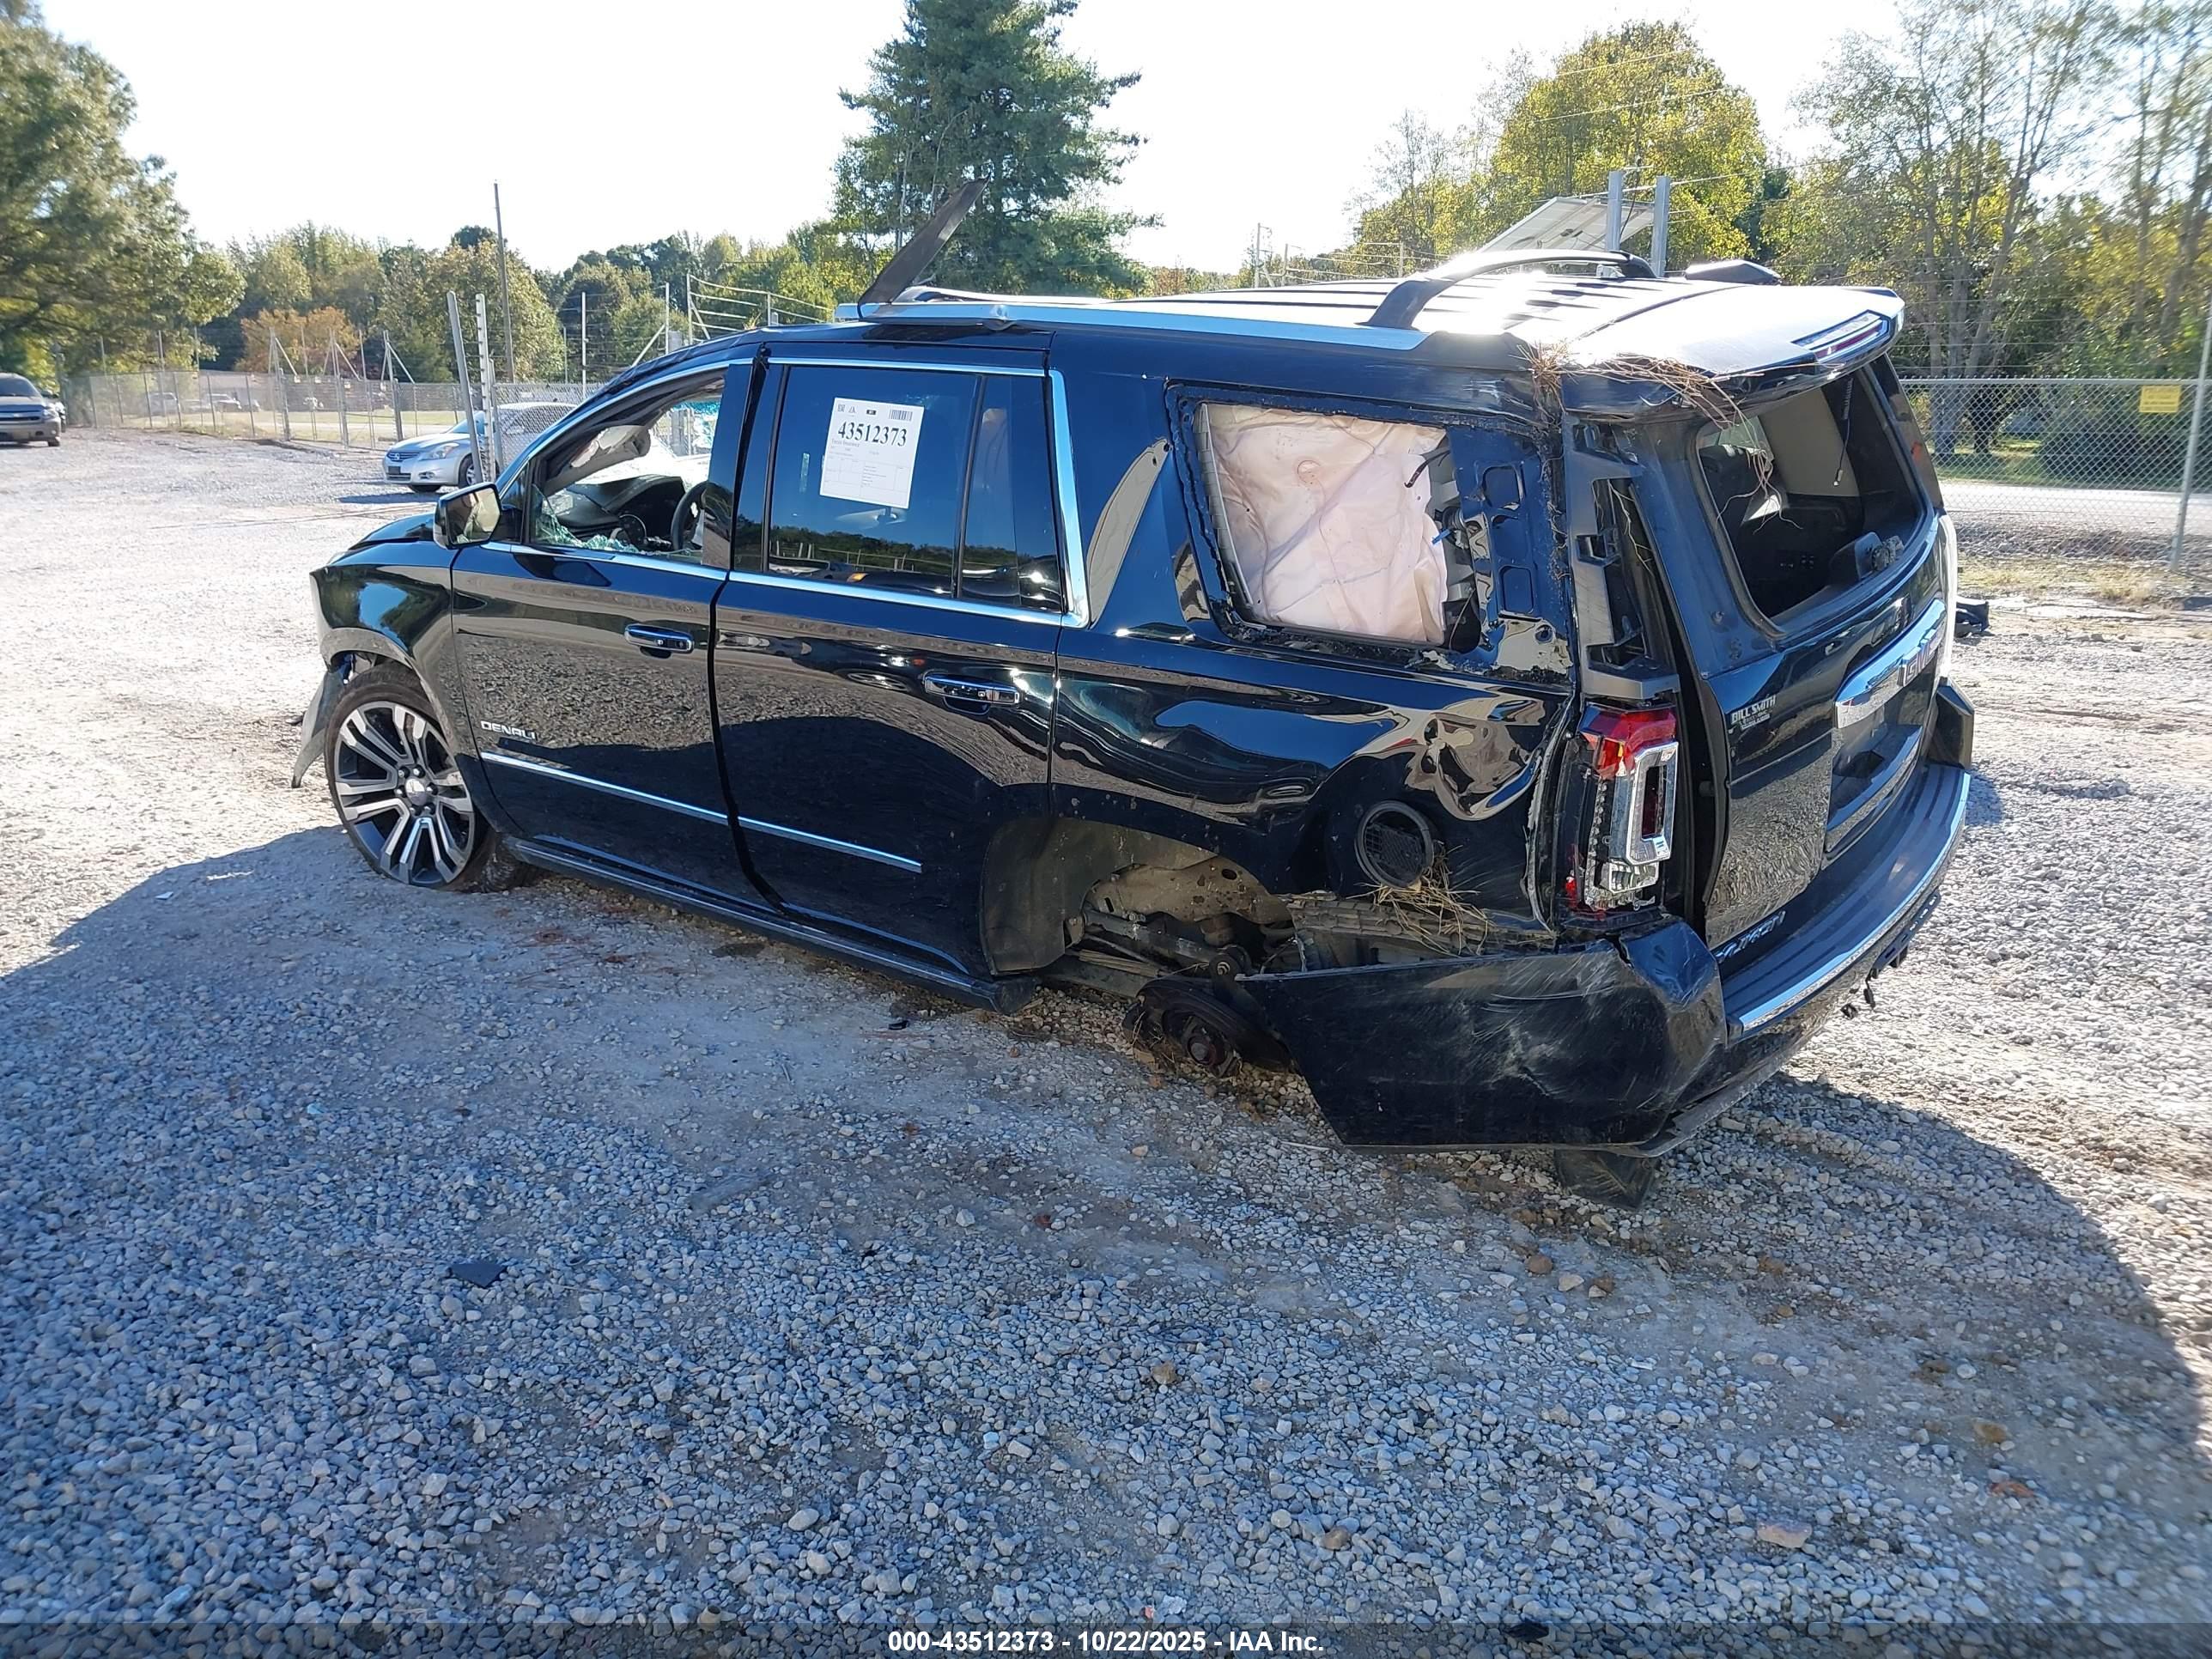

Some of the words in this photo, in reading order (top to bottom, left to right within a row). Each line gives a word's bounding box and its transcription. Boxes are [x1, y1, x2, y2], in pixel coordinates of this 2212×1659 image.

[837, 421, 908, 447] 43512373
[1730, 706, 1752, 725] BILL
[1751, 695, 1777, 715] SMITH
[480, 720, 537, 739] DENALI
